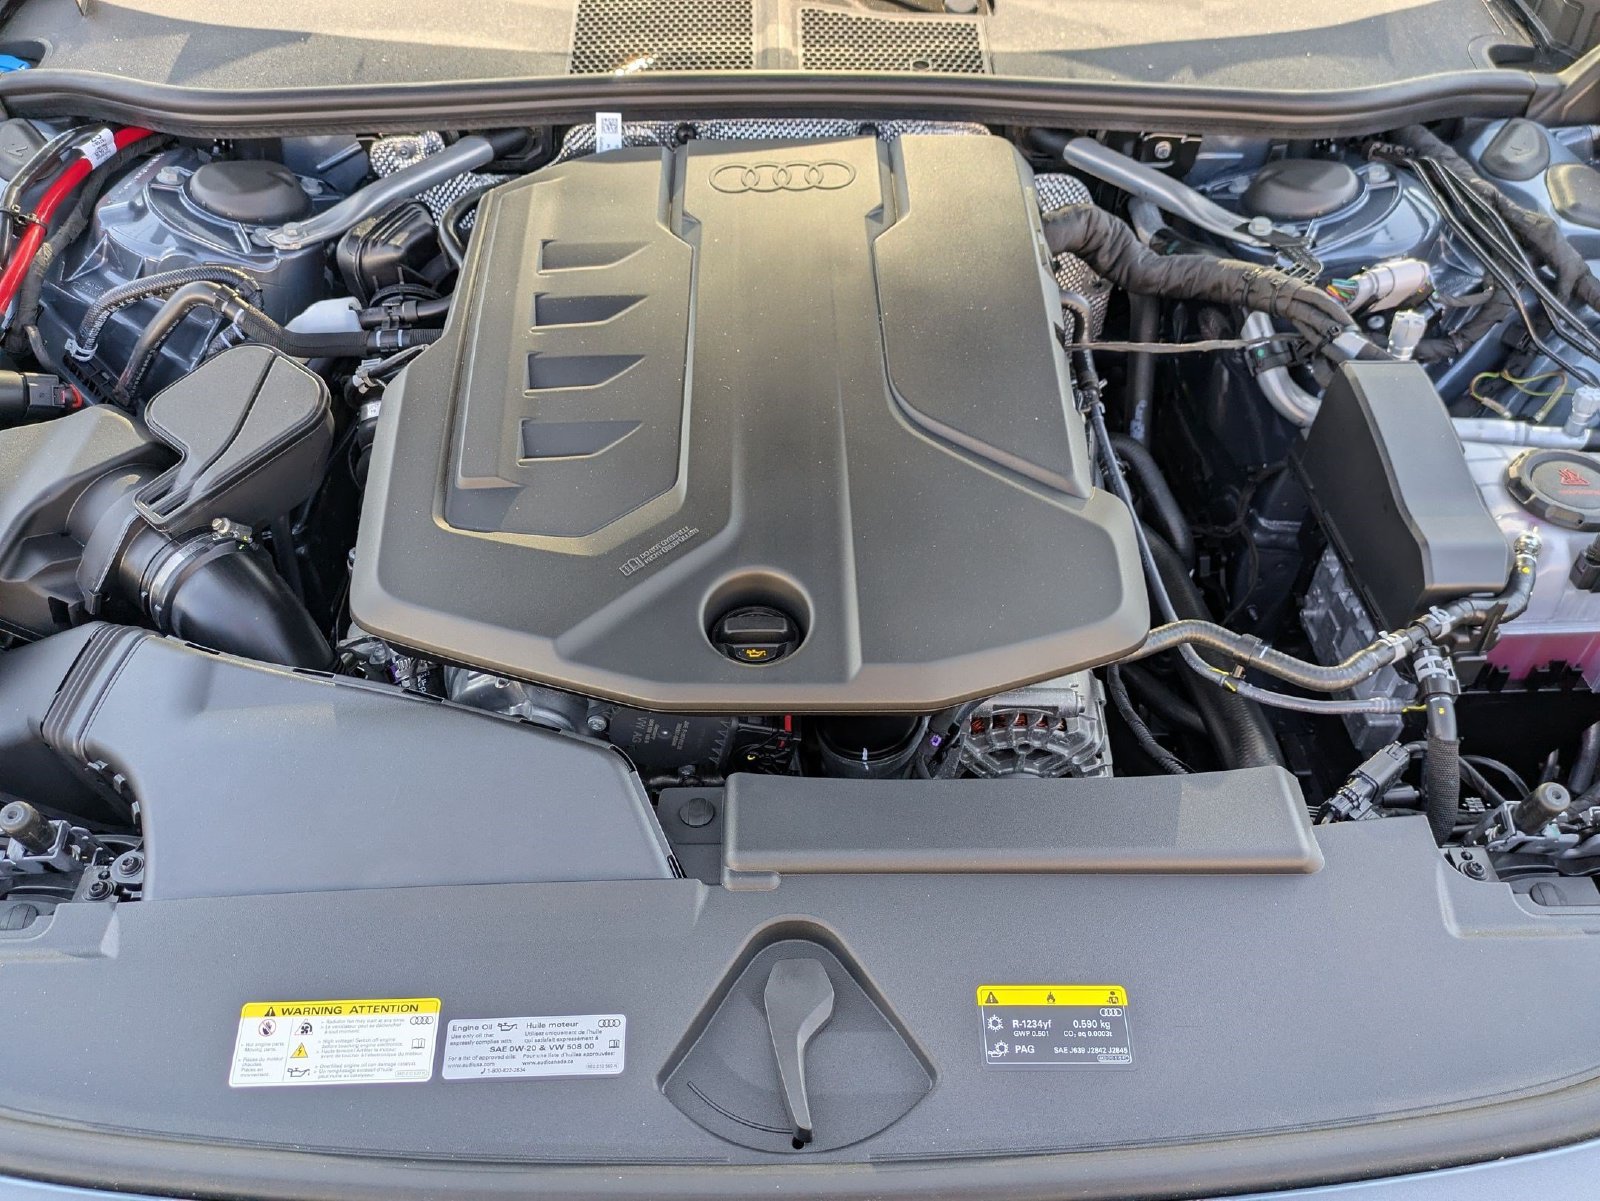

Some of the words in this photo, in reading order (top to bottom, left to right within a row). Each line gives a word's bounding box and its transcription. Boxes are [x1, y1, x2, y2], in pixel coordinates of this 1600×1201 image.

[281, 1006, 343, 1016] WARNING
[348, 1004, 419, 1014] ATTENTION
[452, 1024, 480, 1032] Engine
[1012, 1020, 1052, 1029] R-1234yf
[1072, 1020, 1097, 1028] 0.590
[1100, 1020, 1111, 1030] kg
[1015, 1045, 1035, 1054] PAG
[1087, 1046, 1107, 1054] J2842
